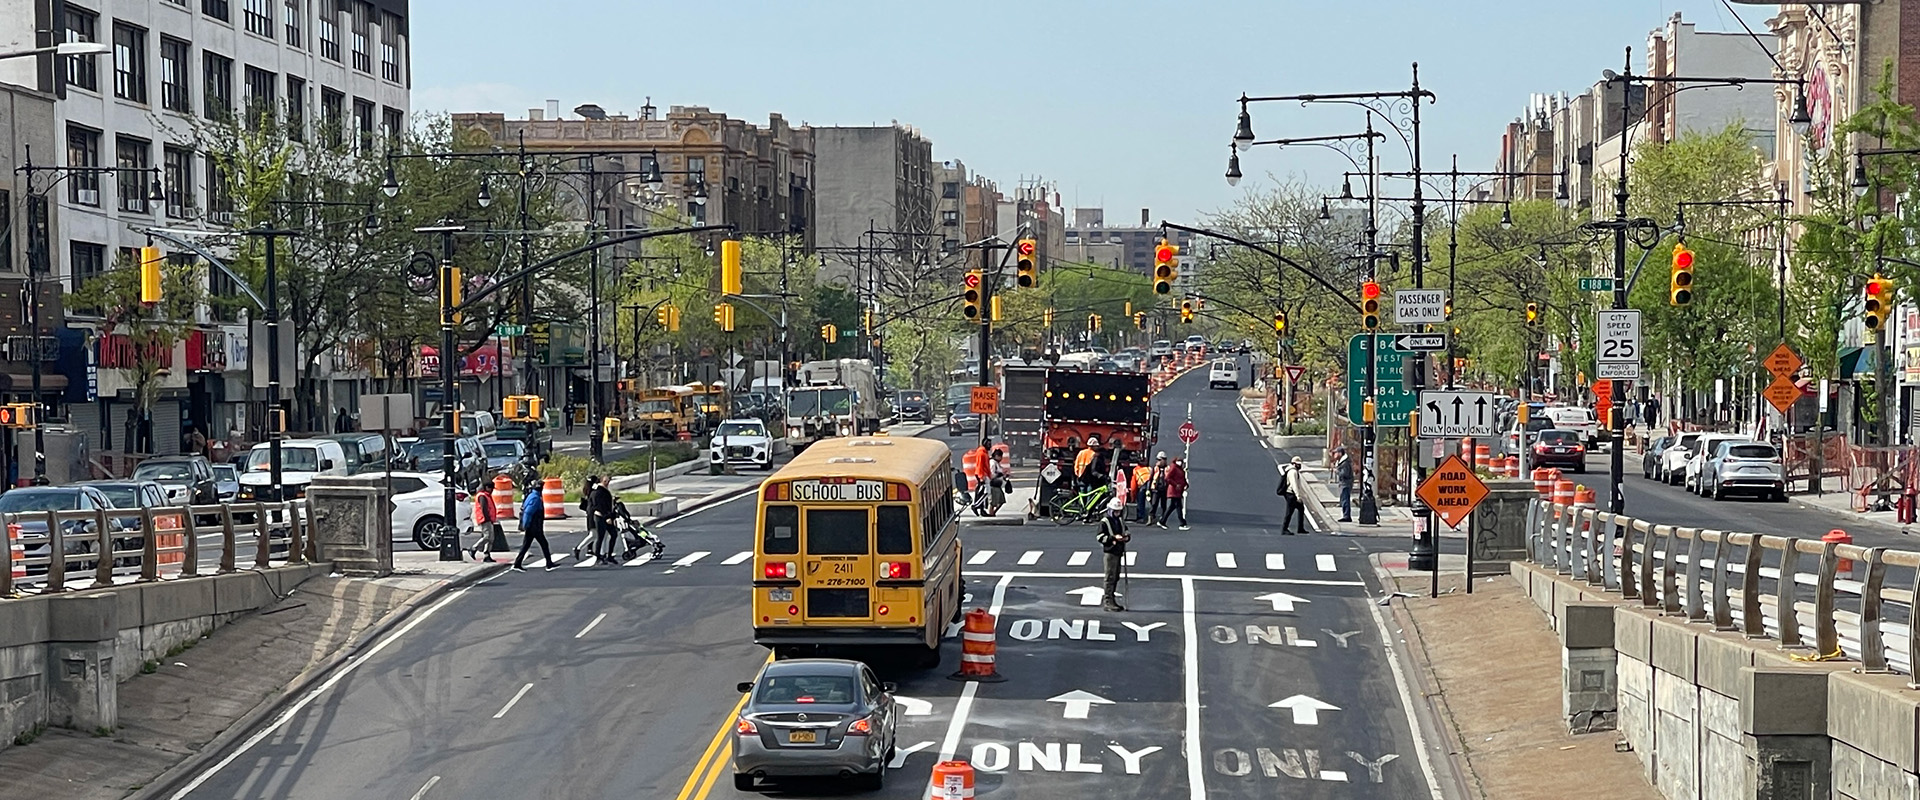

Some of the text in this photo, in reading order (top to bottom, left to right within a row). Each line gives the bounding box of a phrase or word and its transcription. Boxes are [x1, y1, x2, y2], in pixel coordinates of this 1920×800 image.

[1581, 280, 1586, 289] E
[1589, 280, 1602, 289] 188
[1399, 294, 1441, 304] PASSENGER
[1400, 307, 1440, 317] CARS ONLY
[1360, 340, 1395, 350] E 84
[1603, 340, 1634, 357] 25
[973, 391, 995, 400] RAISE
[1360, 386, 1367, 396] E
[1379, 386, 1395, 396] 84
[974, 402, 993, 410] PLOW
[1391, 413, 1408, 421] LEF
[1422, 425, 1444, 433] ONLY
[1470, 426, 1491, 434] ONLY
[1440, 472, 1466, 481] ROAD
[794, 484, 881, 500] SCHOOL BUS
[1438, 486, 1467, 494] WORK
[1437, 498, 1469, 507] AHEAD
[834, 563, 853, 573] 2411
[1009, 618, 1167, 641] ONLY
[1208, 625, 1363, 648] ONLY
[971, 742, 1163, 774] ONLY
[1213, 748, 1400, 784] ONLY
